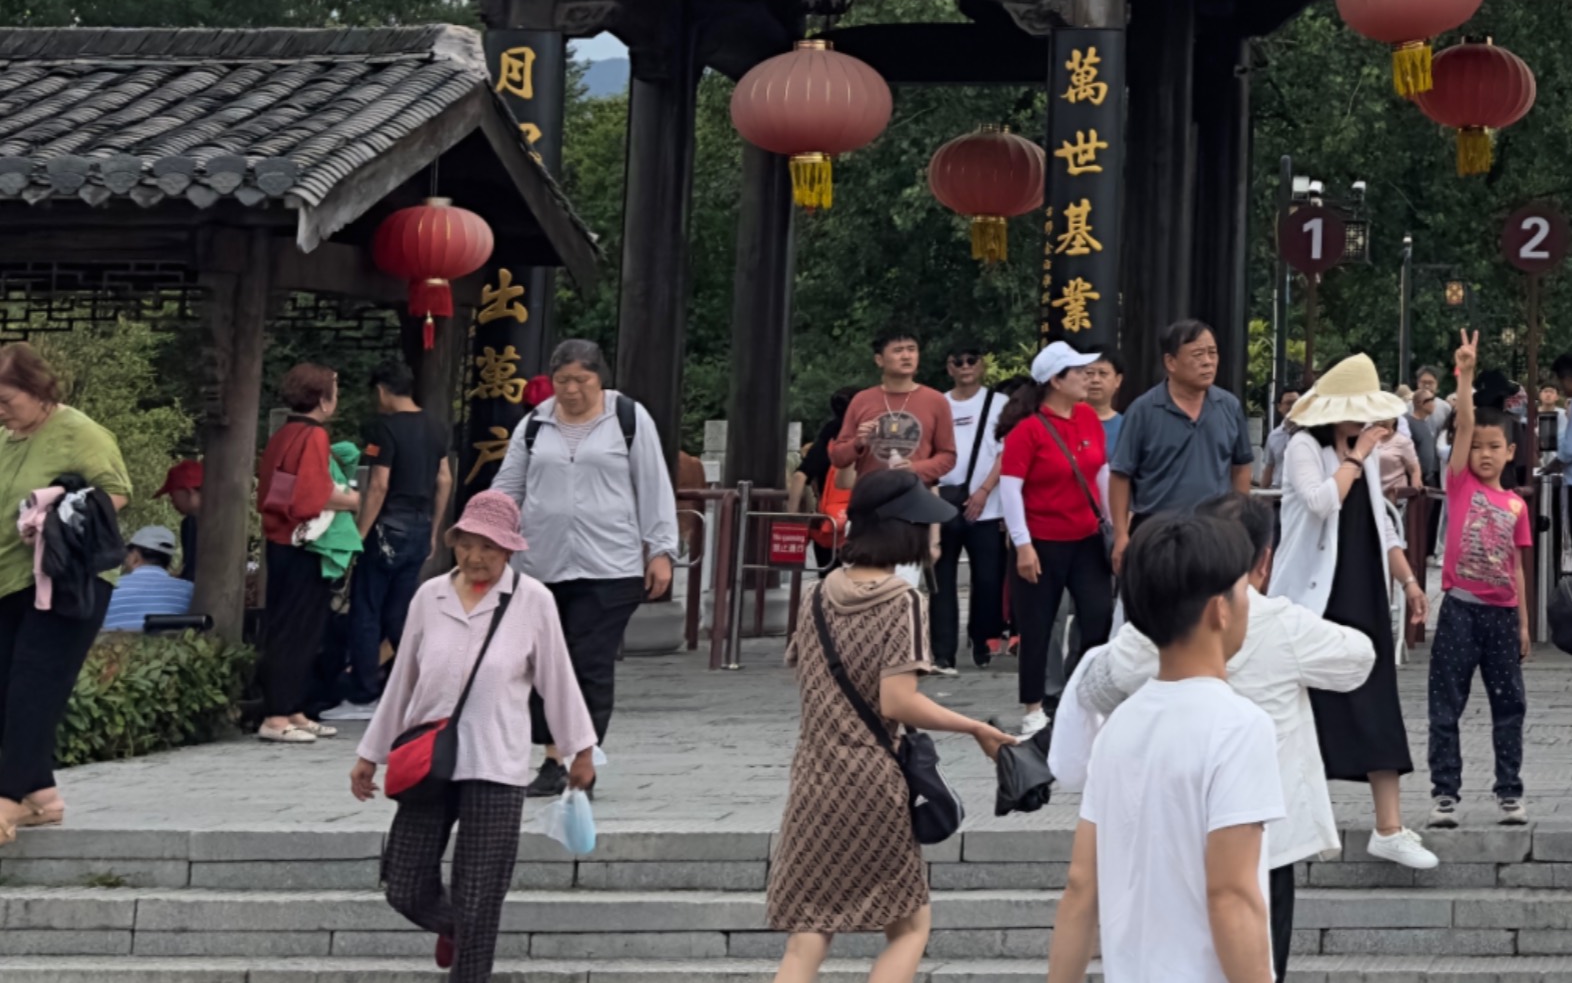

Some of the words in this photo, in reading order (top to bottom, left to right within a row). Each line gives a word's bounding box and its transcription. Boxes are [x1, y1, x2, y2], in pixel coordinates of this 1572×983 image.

[1052, 46, 1109, 332] 萬世基業
[1302, 218, 1323, 259] 1
[1519, 216, 1550, 259] 2
